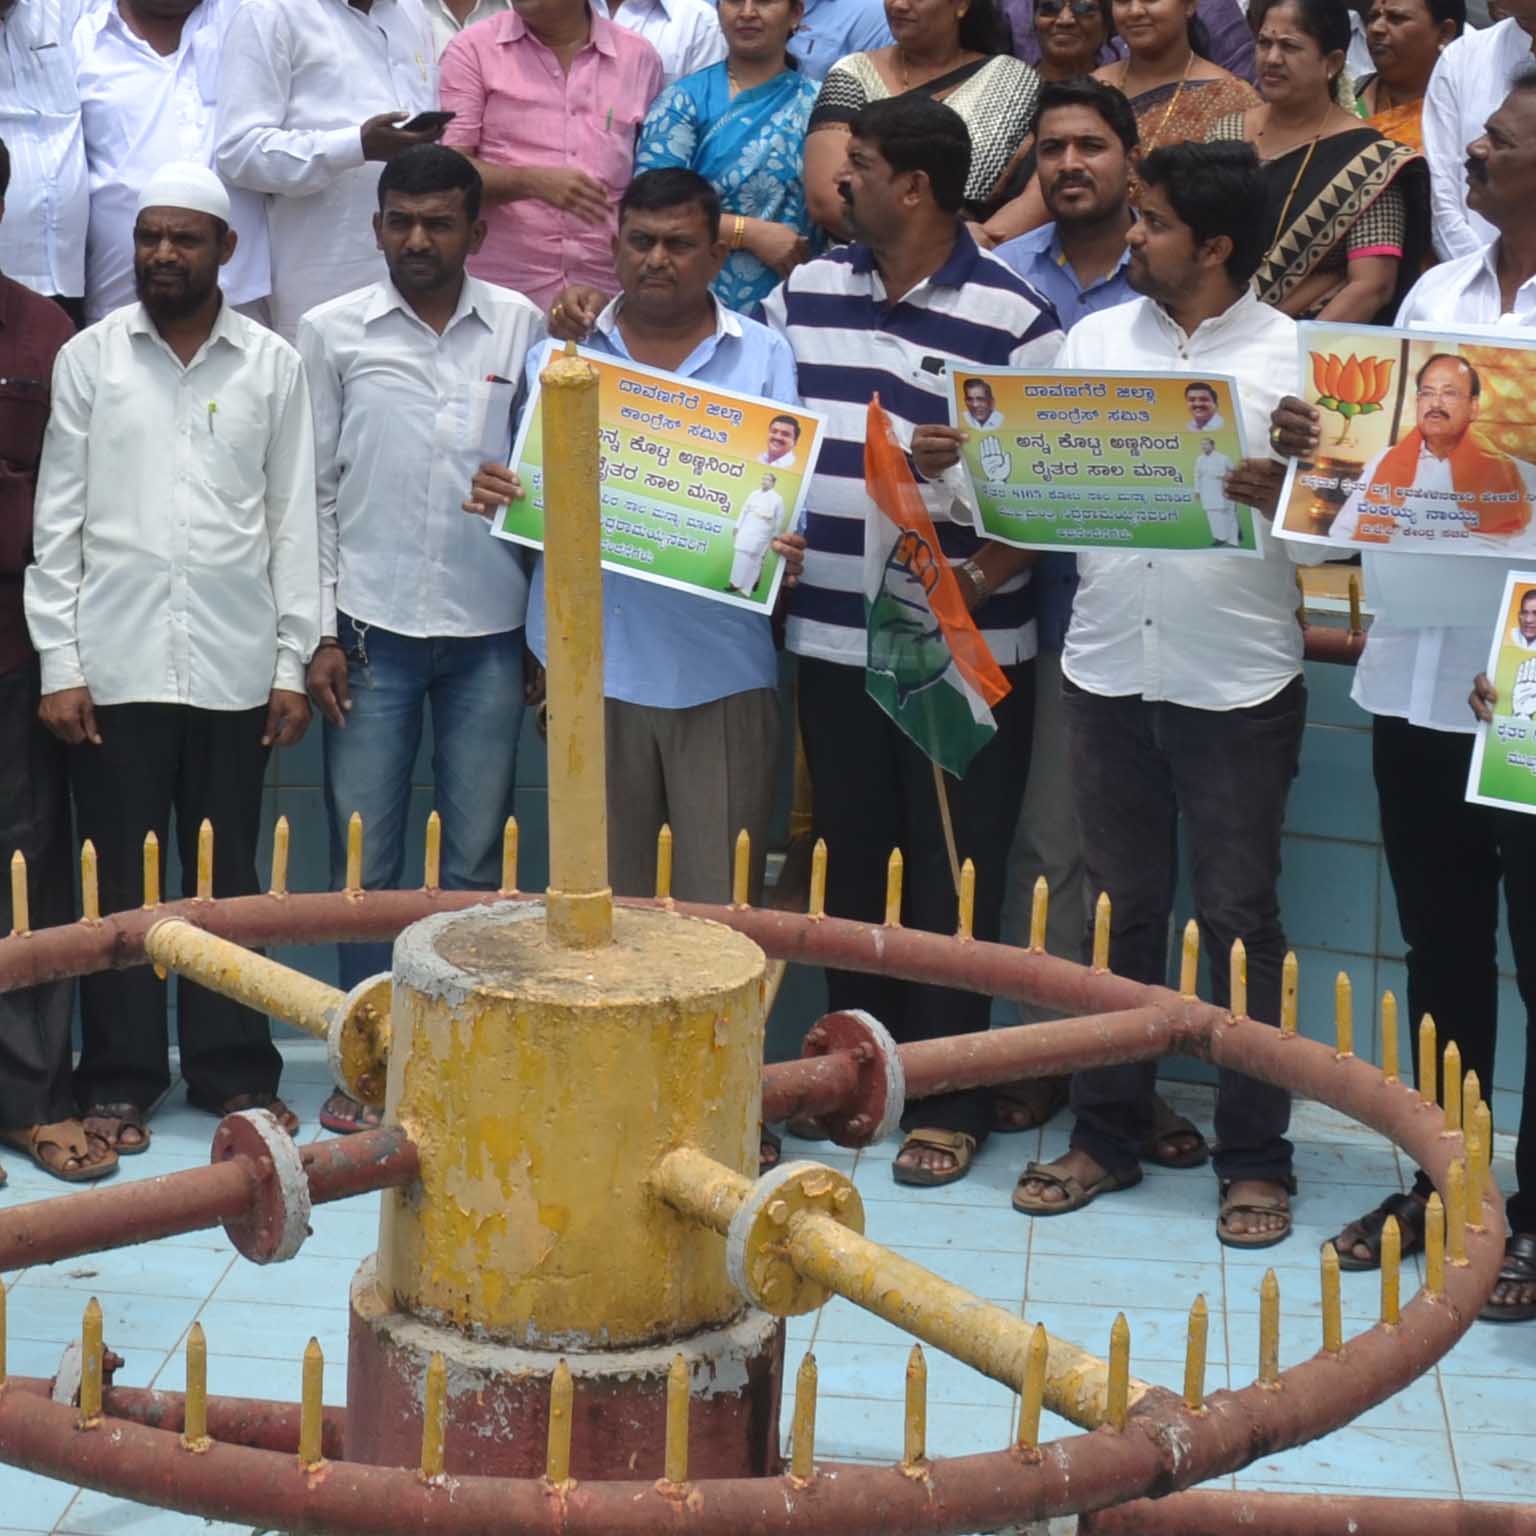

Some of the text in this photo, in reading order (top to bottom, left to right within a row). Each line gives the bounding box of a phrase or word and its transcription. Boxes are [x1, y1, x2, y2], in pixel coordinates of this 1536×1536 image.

[619, 378, 743, 427] ದಾವಣಗೆರೆ ಜಿಲ್ಲಾ
[1025, 384, 1156, 404] ದಾವಣಗೆರೆ ಜಿಲ್ಲಾ
[621, 406, 729, 444] ಕಾಂಗ್ರೆಸ್ ಸಮಿತಿ
[1037, 408, 1151, 424] ಕಾಂಗ್ರೆಸ್ ಸಮಿತಿ
[630, 435, 671, 466] ಕೊಟ್ಟ
[679, 449, 745, 477] ಅಣ್ಣನಿಂದ
[1017, 434, 1179, 457] ಅನ್ನ ಕೊಟ್ಟ ಅಣ್ಣನಿಂದ
[1033, 462, 1183, 484] ರೈತರ ಸಾಲ ಮನ್ನಾ
[645, 472, 679, 492] ಸಾಲ
[688, 483, 731, 513] ಮನ್ನಾ
